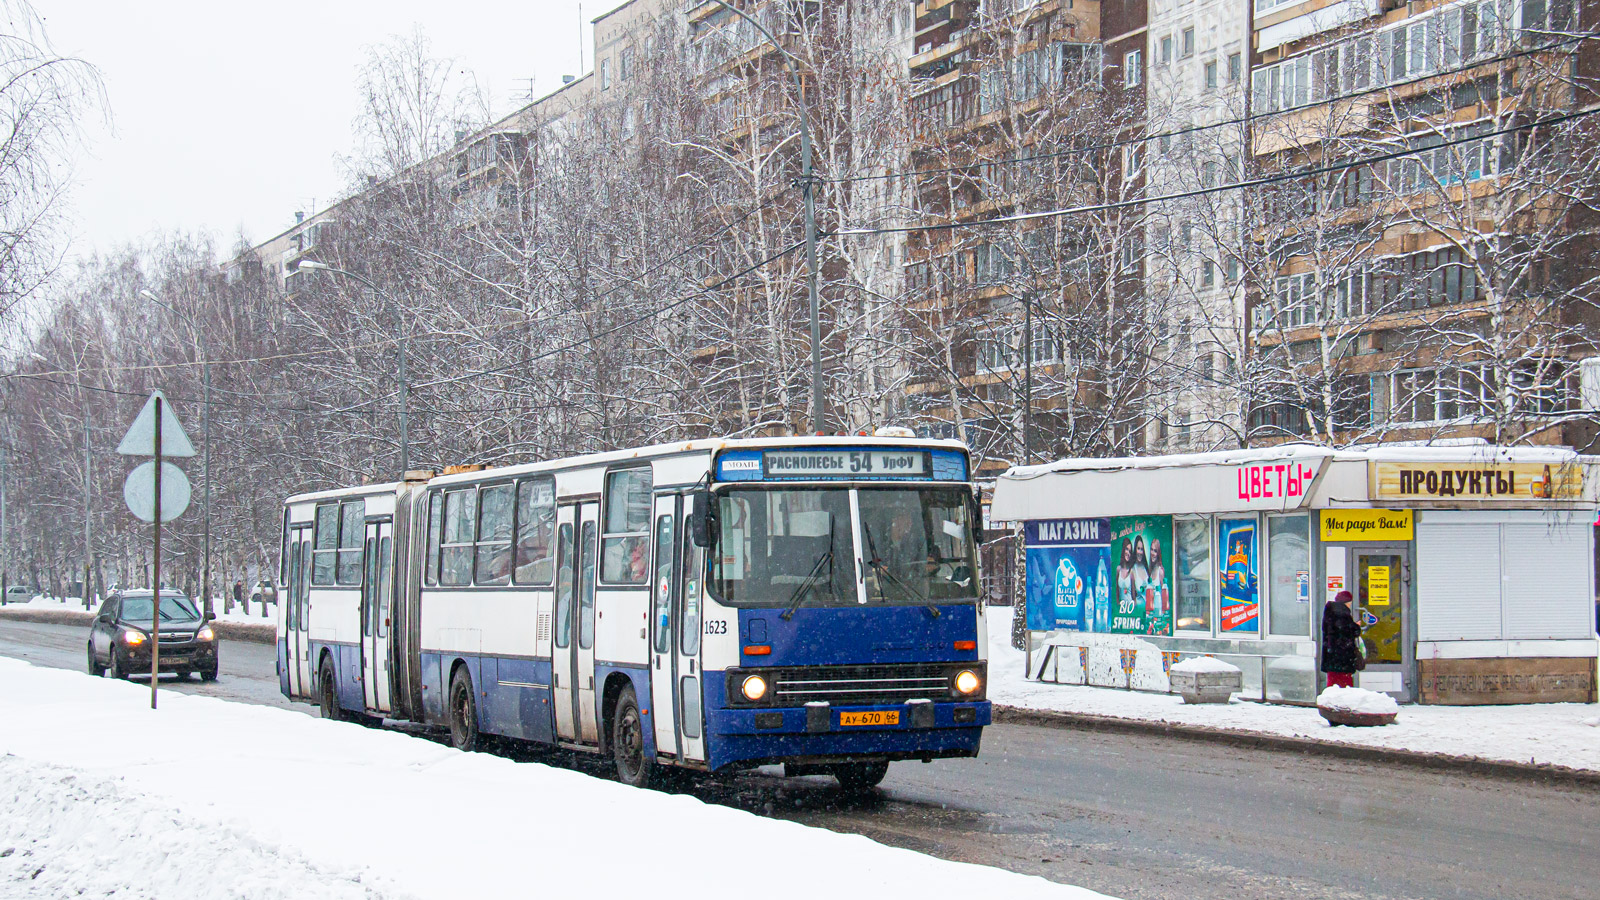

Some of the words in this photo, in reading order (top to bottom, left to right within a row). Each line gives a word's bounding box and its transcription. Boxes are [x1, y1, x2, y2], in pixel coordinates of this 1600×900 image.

[766, 456, 843, 469] РАСНОЛЕСЬЕ
[850, 453, 872, 472] 54
[1400, 470, 1515, 497] ПРОДУКТЫ
[1039, 521, 1098, 541] МАГАЗИН
[1326, 518, 1344, 529] Мы
[1346, 520, 1375, 532] рады
[1378, 517, 1407, 528] Вам!
[1119, 600, 1134, 614] BIO
[705, 620, 727, 634] 1623
[1112, 617, 1140, 629] SPRING
[862, 713, 880, 723] 670
[886, 712, 895, 720] 66
